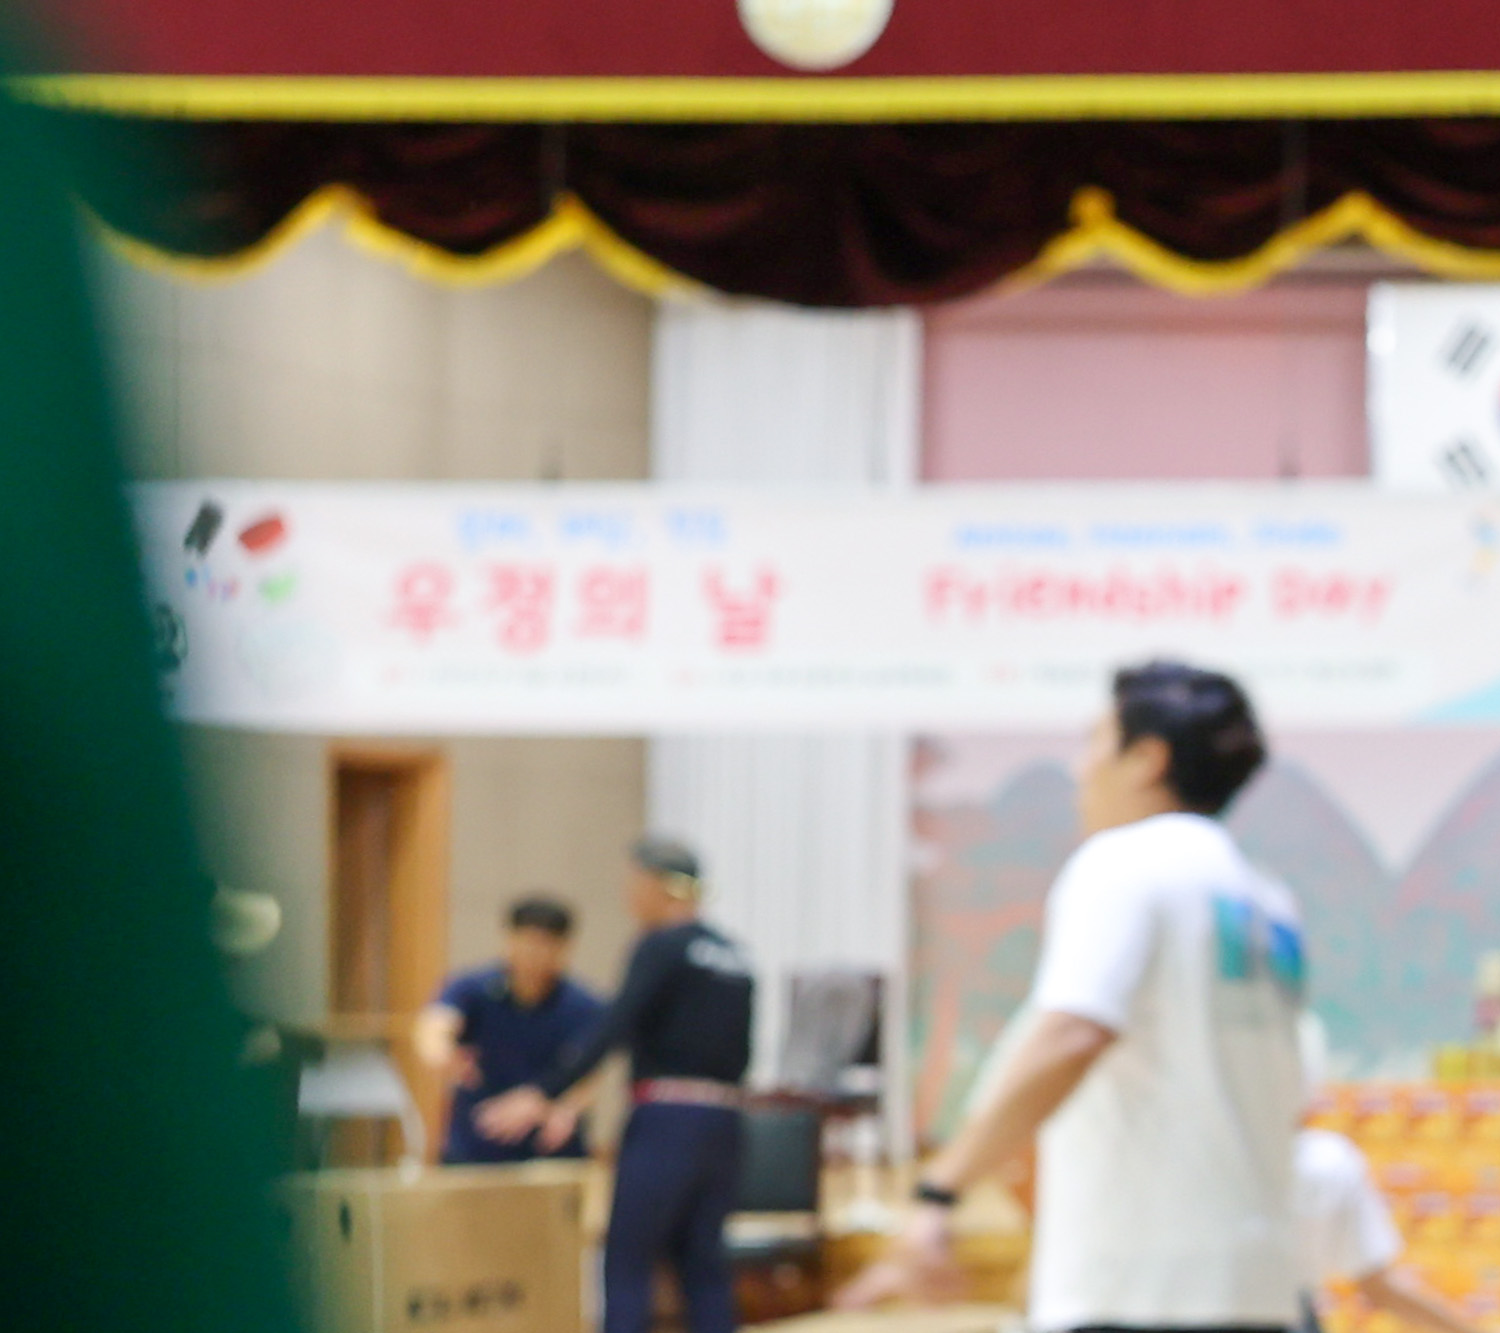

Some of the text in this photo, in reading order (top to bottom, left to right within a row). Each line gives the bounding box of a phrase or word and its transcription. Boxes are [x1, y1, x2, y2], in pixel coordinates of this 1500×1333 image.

[385, 561, 780, 652] 우정의 날
[925, 566, 1392, 624] Friendship Day
